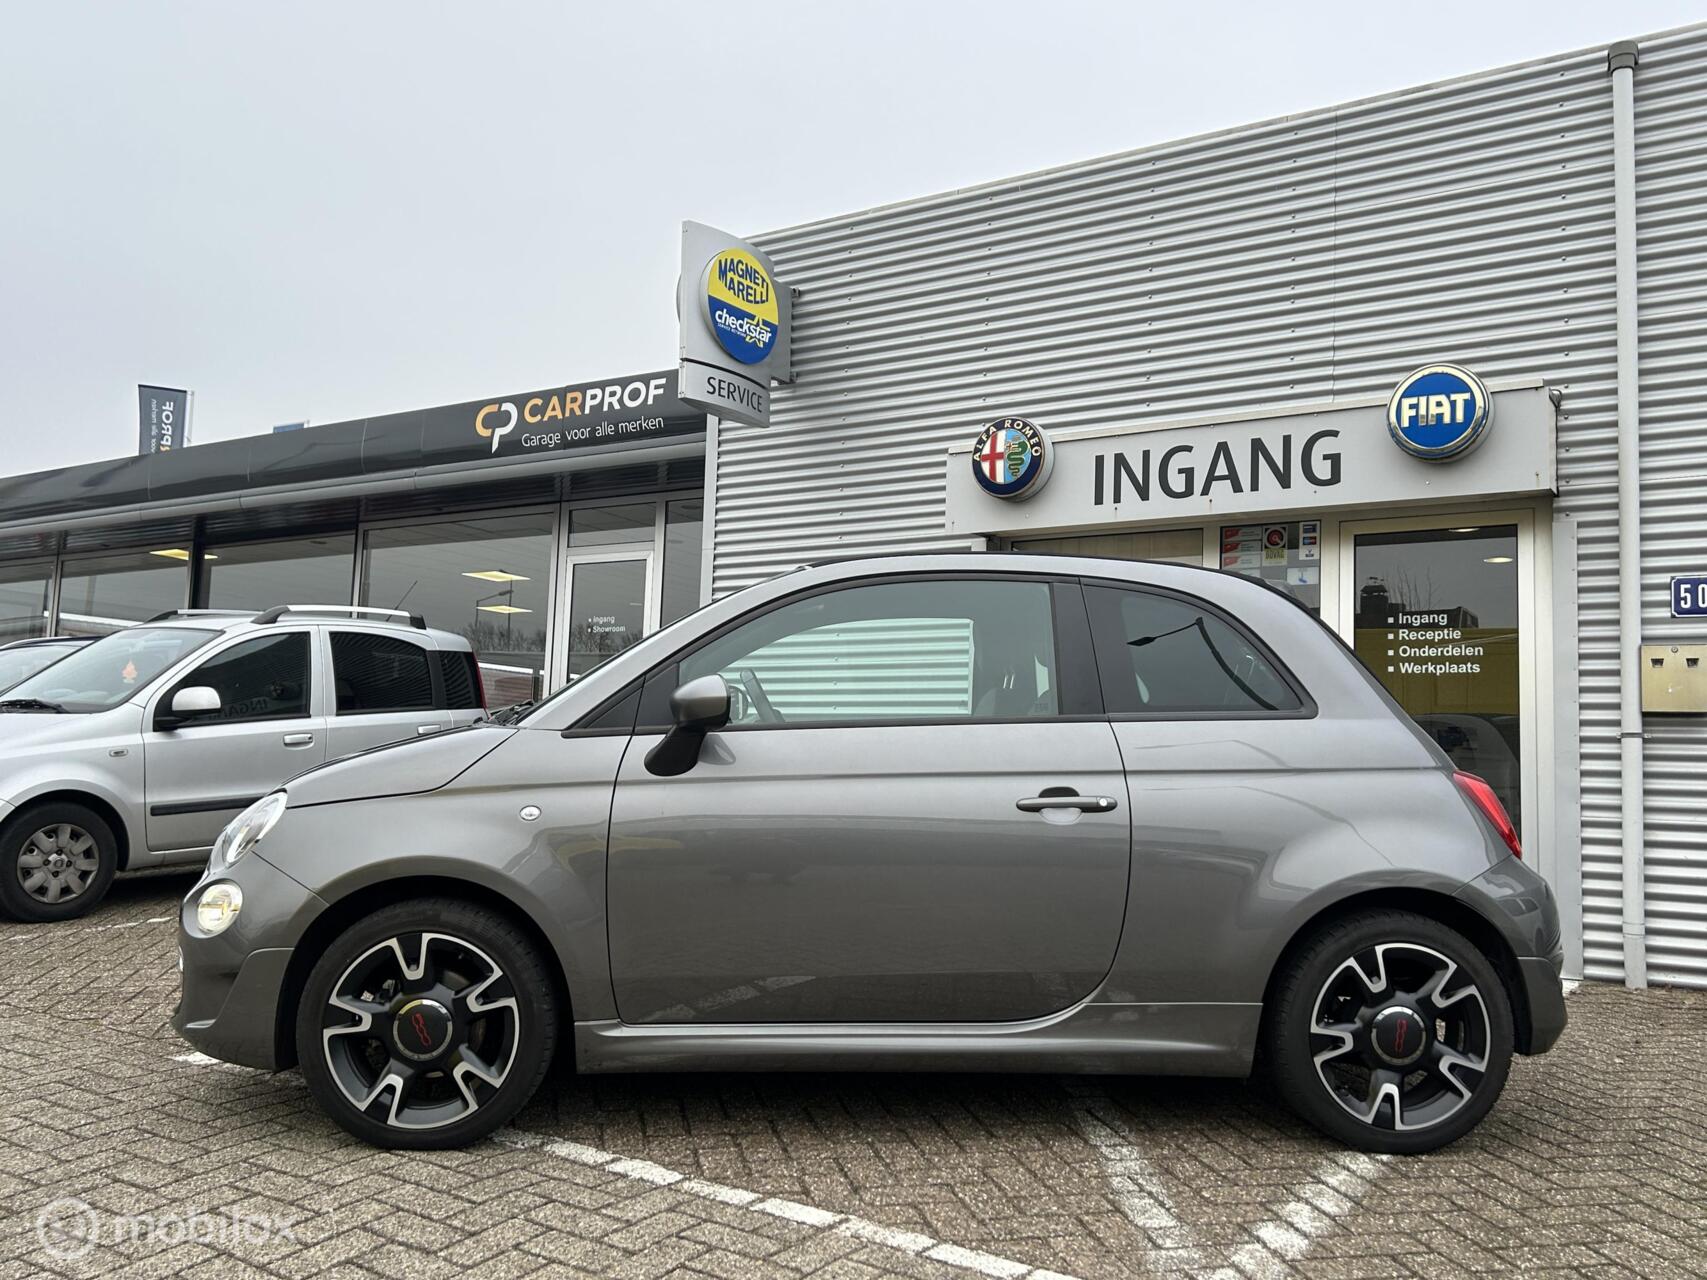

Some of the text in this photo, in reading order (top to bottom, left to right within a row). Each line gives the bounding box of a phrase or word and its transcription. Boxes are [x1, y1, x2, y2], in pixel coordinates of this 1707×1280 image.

[718, 258, 769, 293] MAGNETI
[718, 268, 769, 304] MARELLI
[715, 308, 772, 343] checkstar
[523, 377, 666, 424] CARPROF
[706, 376, 763, 413] SERVICE
[1400, 392, 1471, 428] FIAT
[521, 415, 664, 448] Garage voor alle merken
[973, 419, 1042, 462] ALFA ROMEO
[1094, 428, 1342, 505] INGANG
[1680, 583, 1707, 609] 50
[592, 625, 626, 633] Showroom
[1398, 613, 1448, 626] Ingang
[1398, 628, 1462, 642] Receptie
[1398, 645, 1484, 657] Onderdelen
[1399, 661, 1481, 676] Werkplaats
